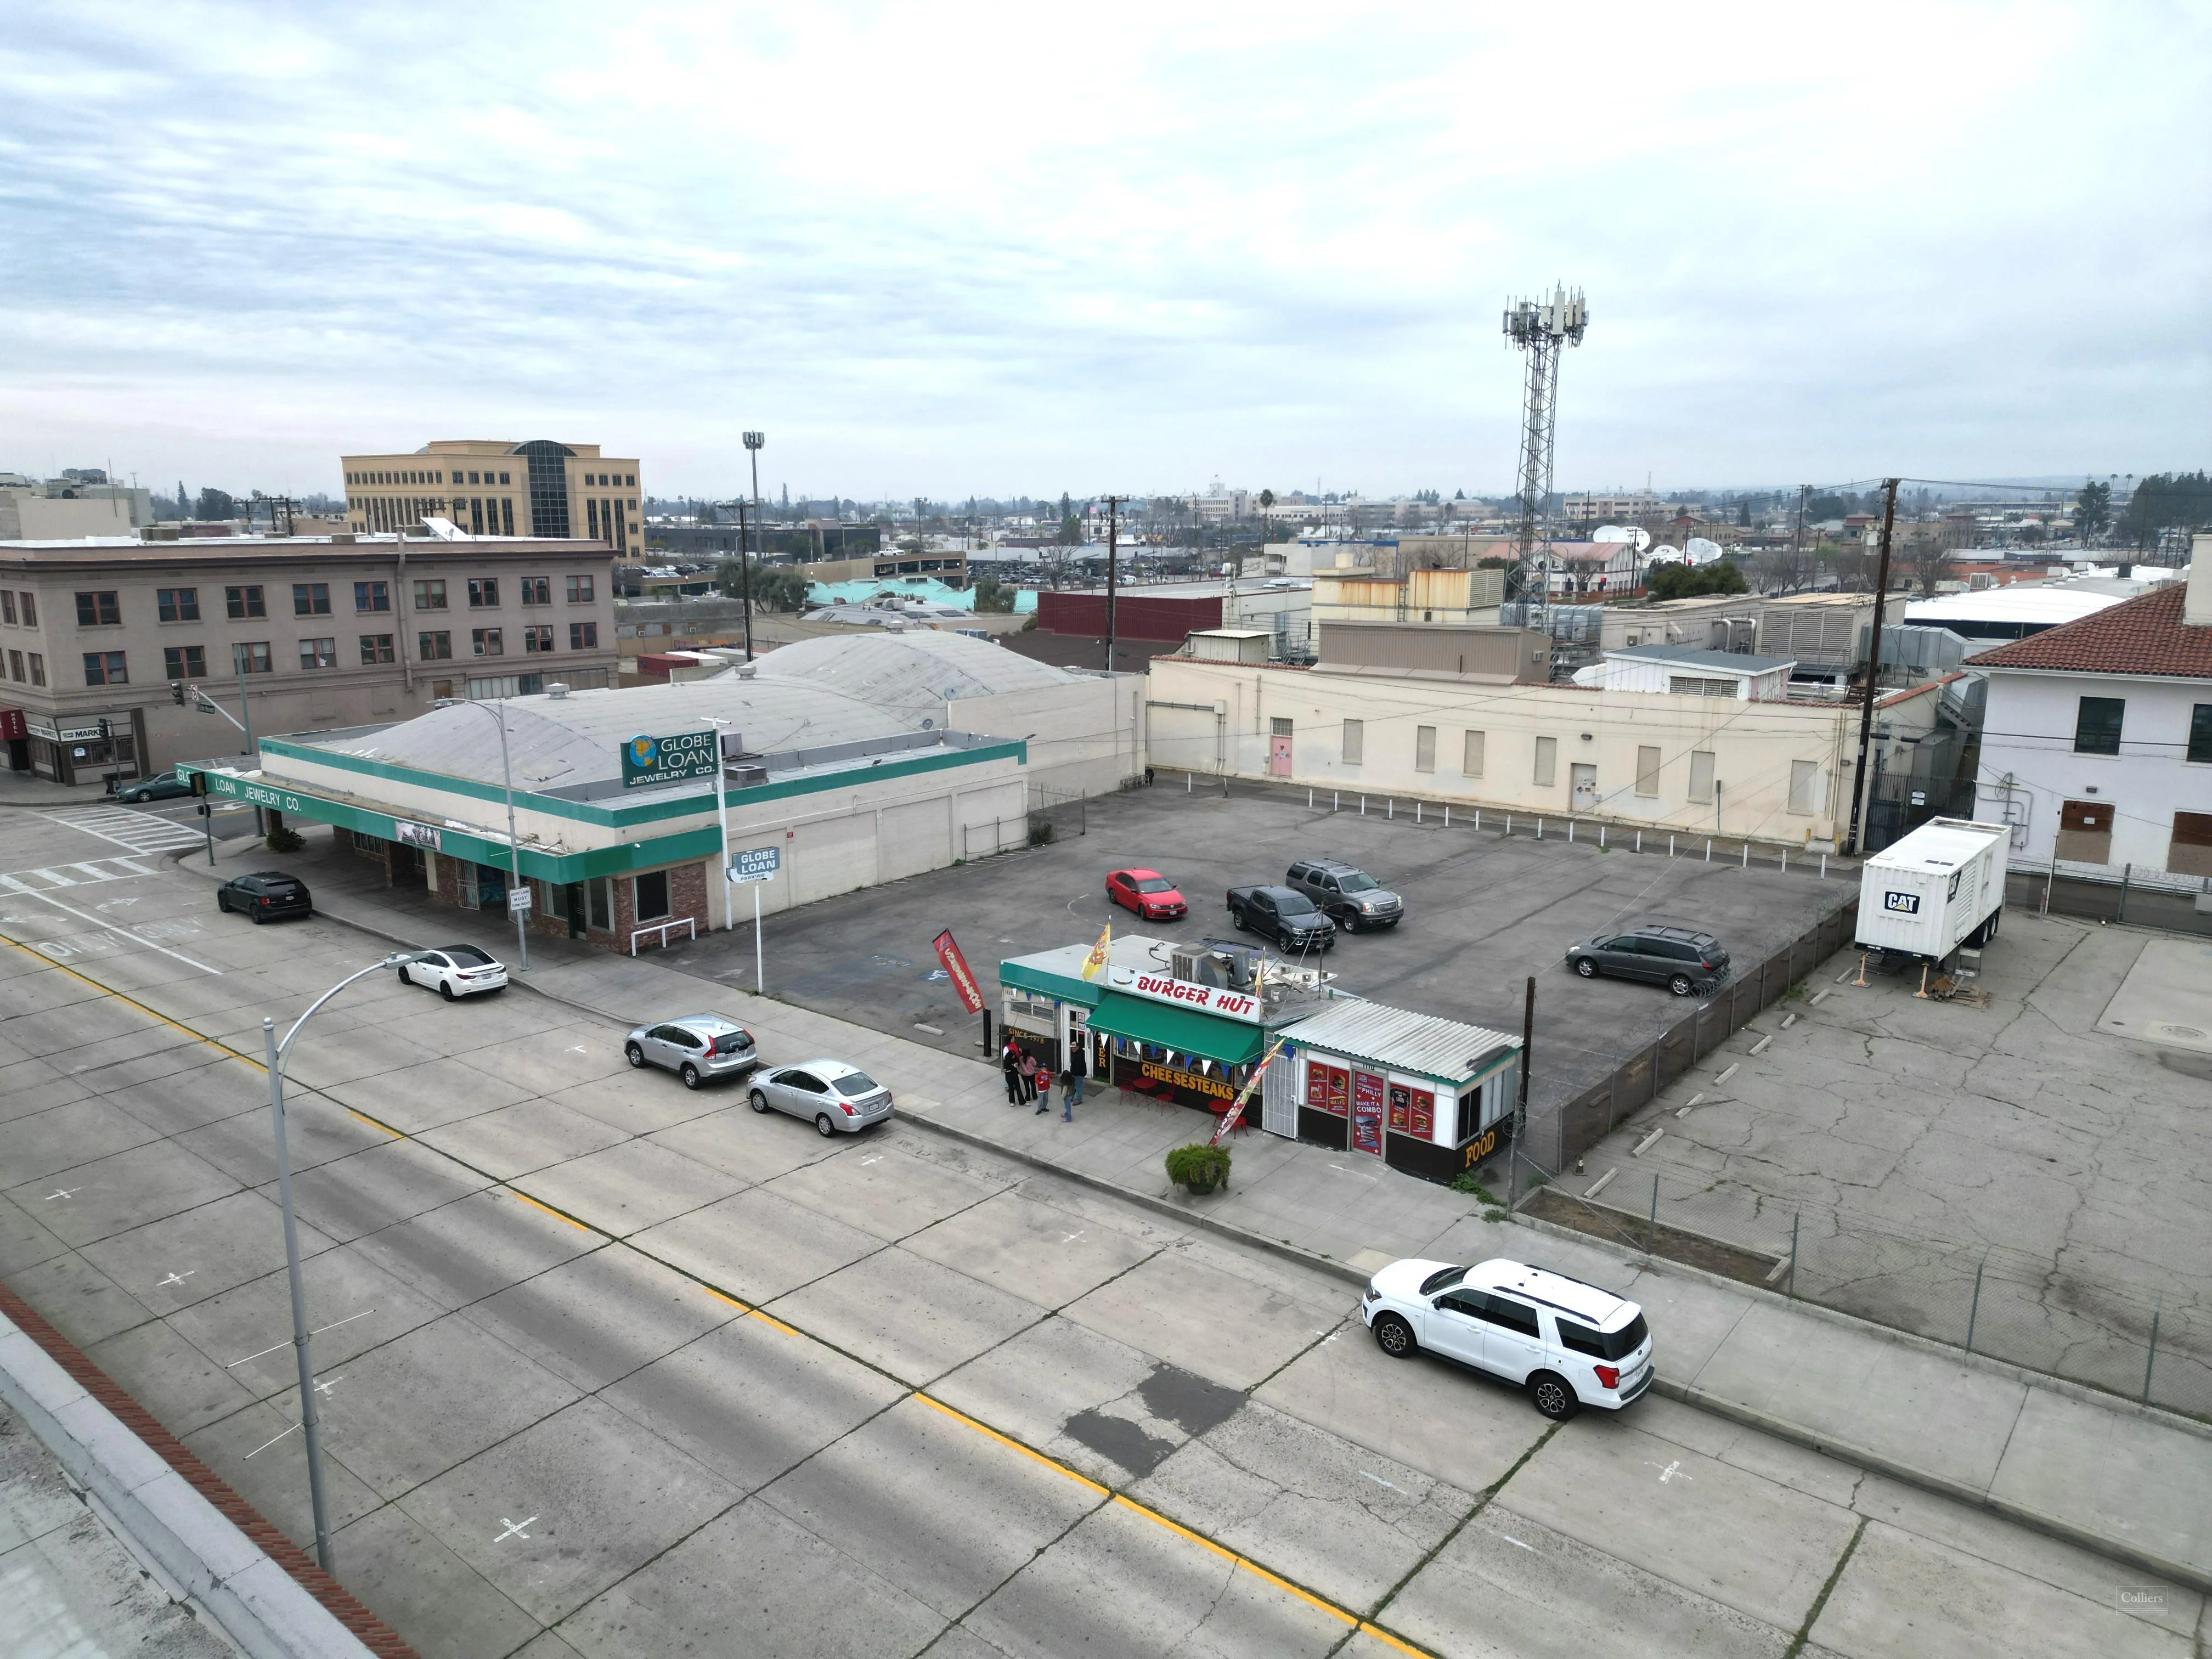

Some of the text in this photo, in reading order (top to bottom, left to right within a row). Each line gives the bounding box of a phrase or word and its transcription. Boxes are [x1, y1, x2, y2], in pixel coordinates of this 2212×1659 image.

[75, 729, 101, 738] MARK
[661, 734, 711, 752] GLOBE
[658, 748, 713, 770] LOAN
[629, 766, 715, 785] JEWELRY CO.
[177, 769, 301, 812] GLO LOAN JEWELRY CO.
[741, 850, 775, 864] GLOBE
[741, 860, 775, 873] LOAN
[1888, 894, 1916, 912] CAT
[1137, 977, 1255, 1014] BURGER HUT
[1008, 1028, 1028, 1040] SINCE
[1142, 1063, 1234, 1101] CHEESESTEAKS
[1362, 1088, 1381, 1097] PHILLY
[1465, 1131, 1494, 1167] FOOD
